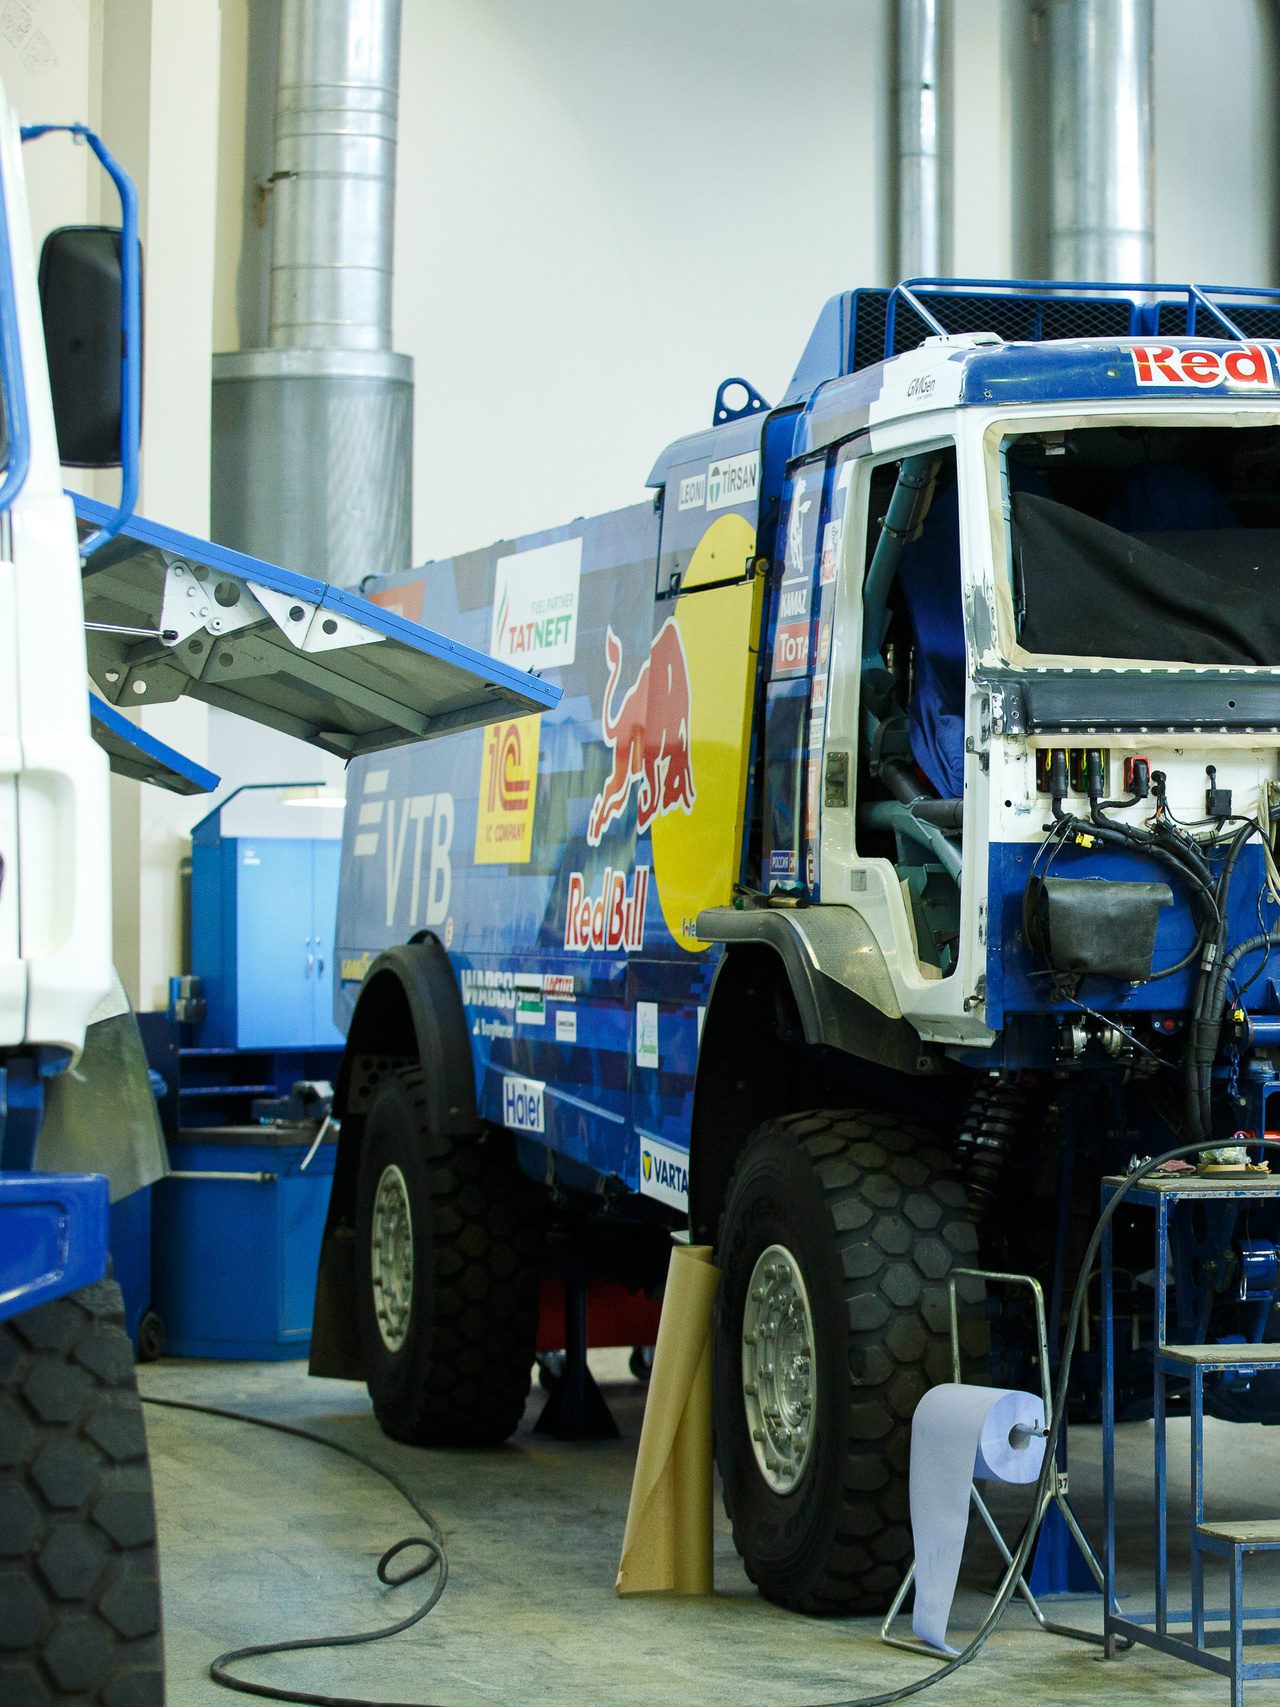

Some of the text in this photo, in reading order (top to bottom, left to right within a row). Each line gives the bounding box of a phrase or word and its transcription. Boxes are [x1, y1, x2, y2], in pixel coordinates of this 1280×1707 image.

[1131, 344, 1275, 389] Red
[681, 480, 705, 505] LEONI
[780, 588, 807, 618] KAMAZ
[509, 614, 572, 655] TATNEFT
[780, 632, 809, 662] TOTA
[386, 792, 454, 927] VTB
[565, 866, 649, 952] Red Bull
[506, 1082, 541, 1128] Haier
[654, 1156, 688, 1195] VARTA
